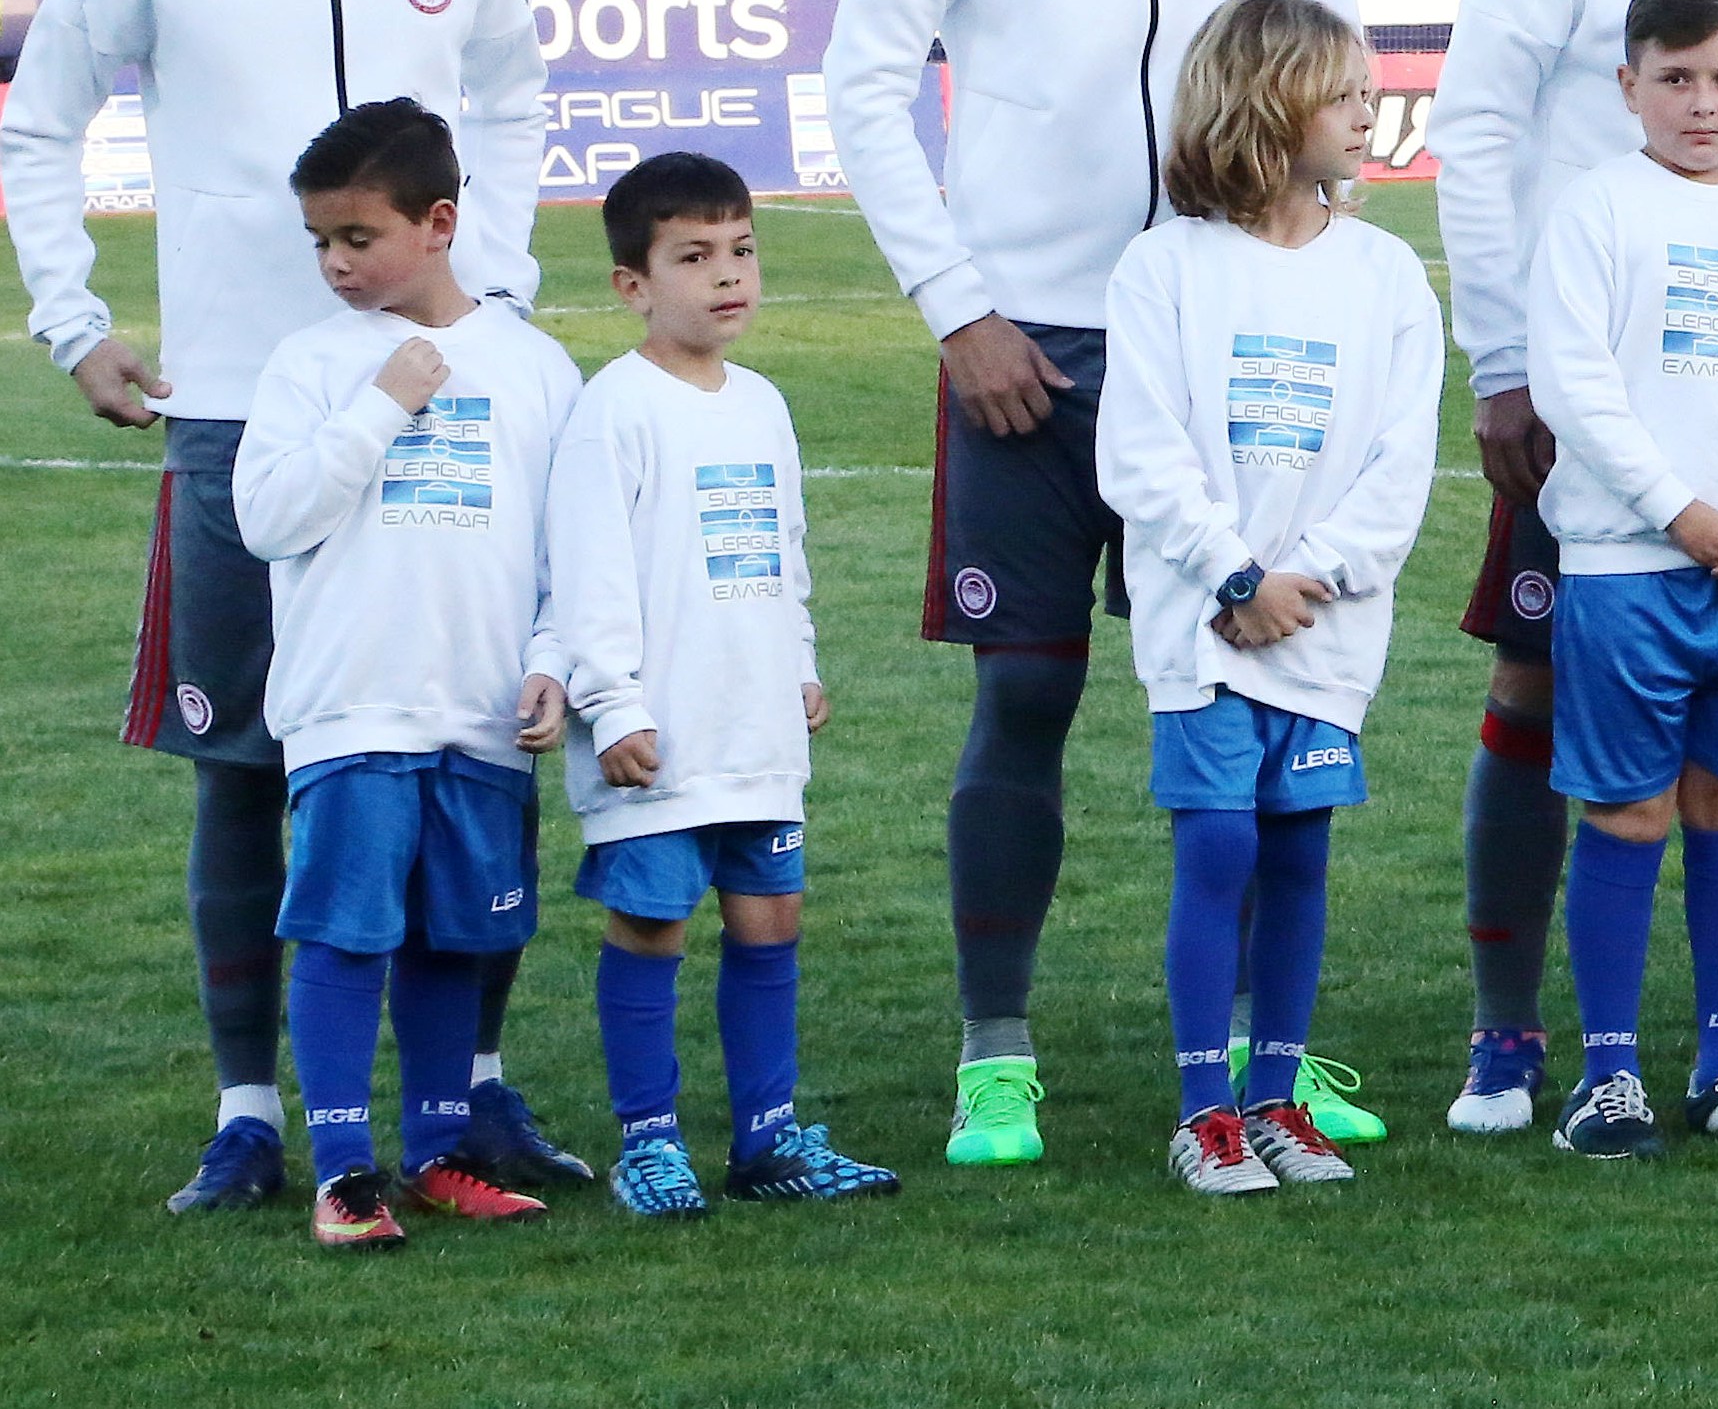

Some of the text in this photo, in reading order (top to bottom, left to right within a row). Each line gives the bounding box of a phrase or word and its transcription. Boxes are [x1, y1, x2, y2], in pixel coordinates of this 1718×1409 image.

[1241, 360, 1326, 382] SUPER
[1228, 403, 1330, 427] LEAGUE
[384, 461, 493, 482] LEAGUE
[708, 490, 774, 508] SUPER
[381, 508, 490, 530] ΕΛΛΑΔΑ
